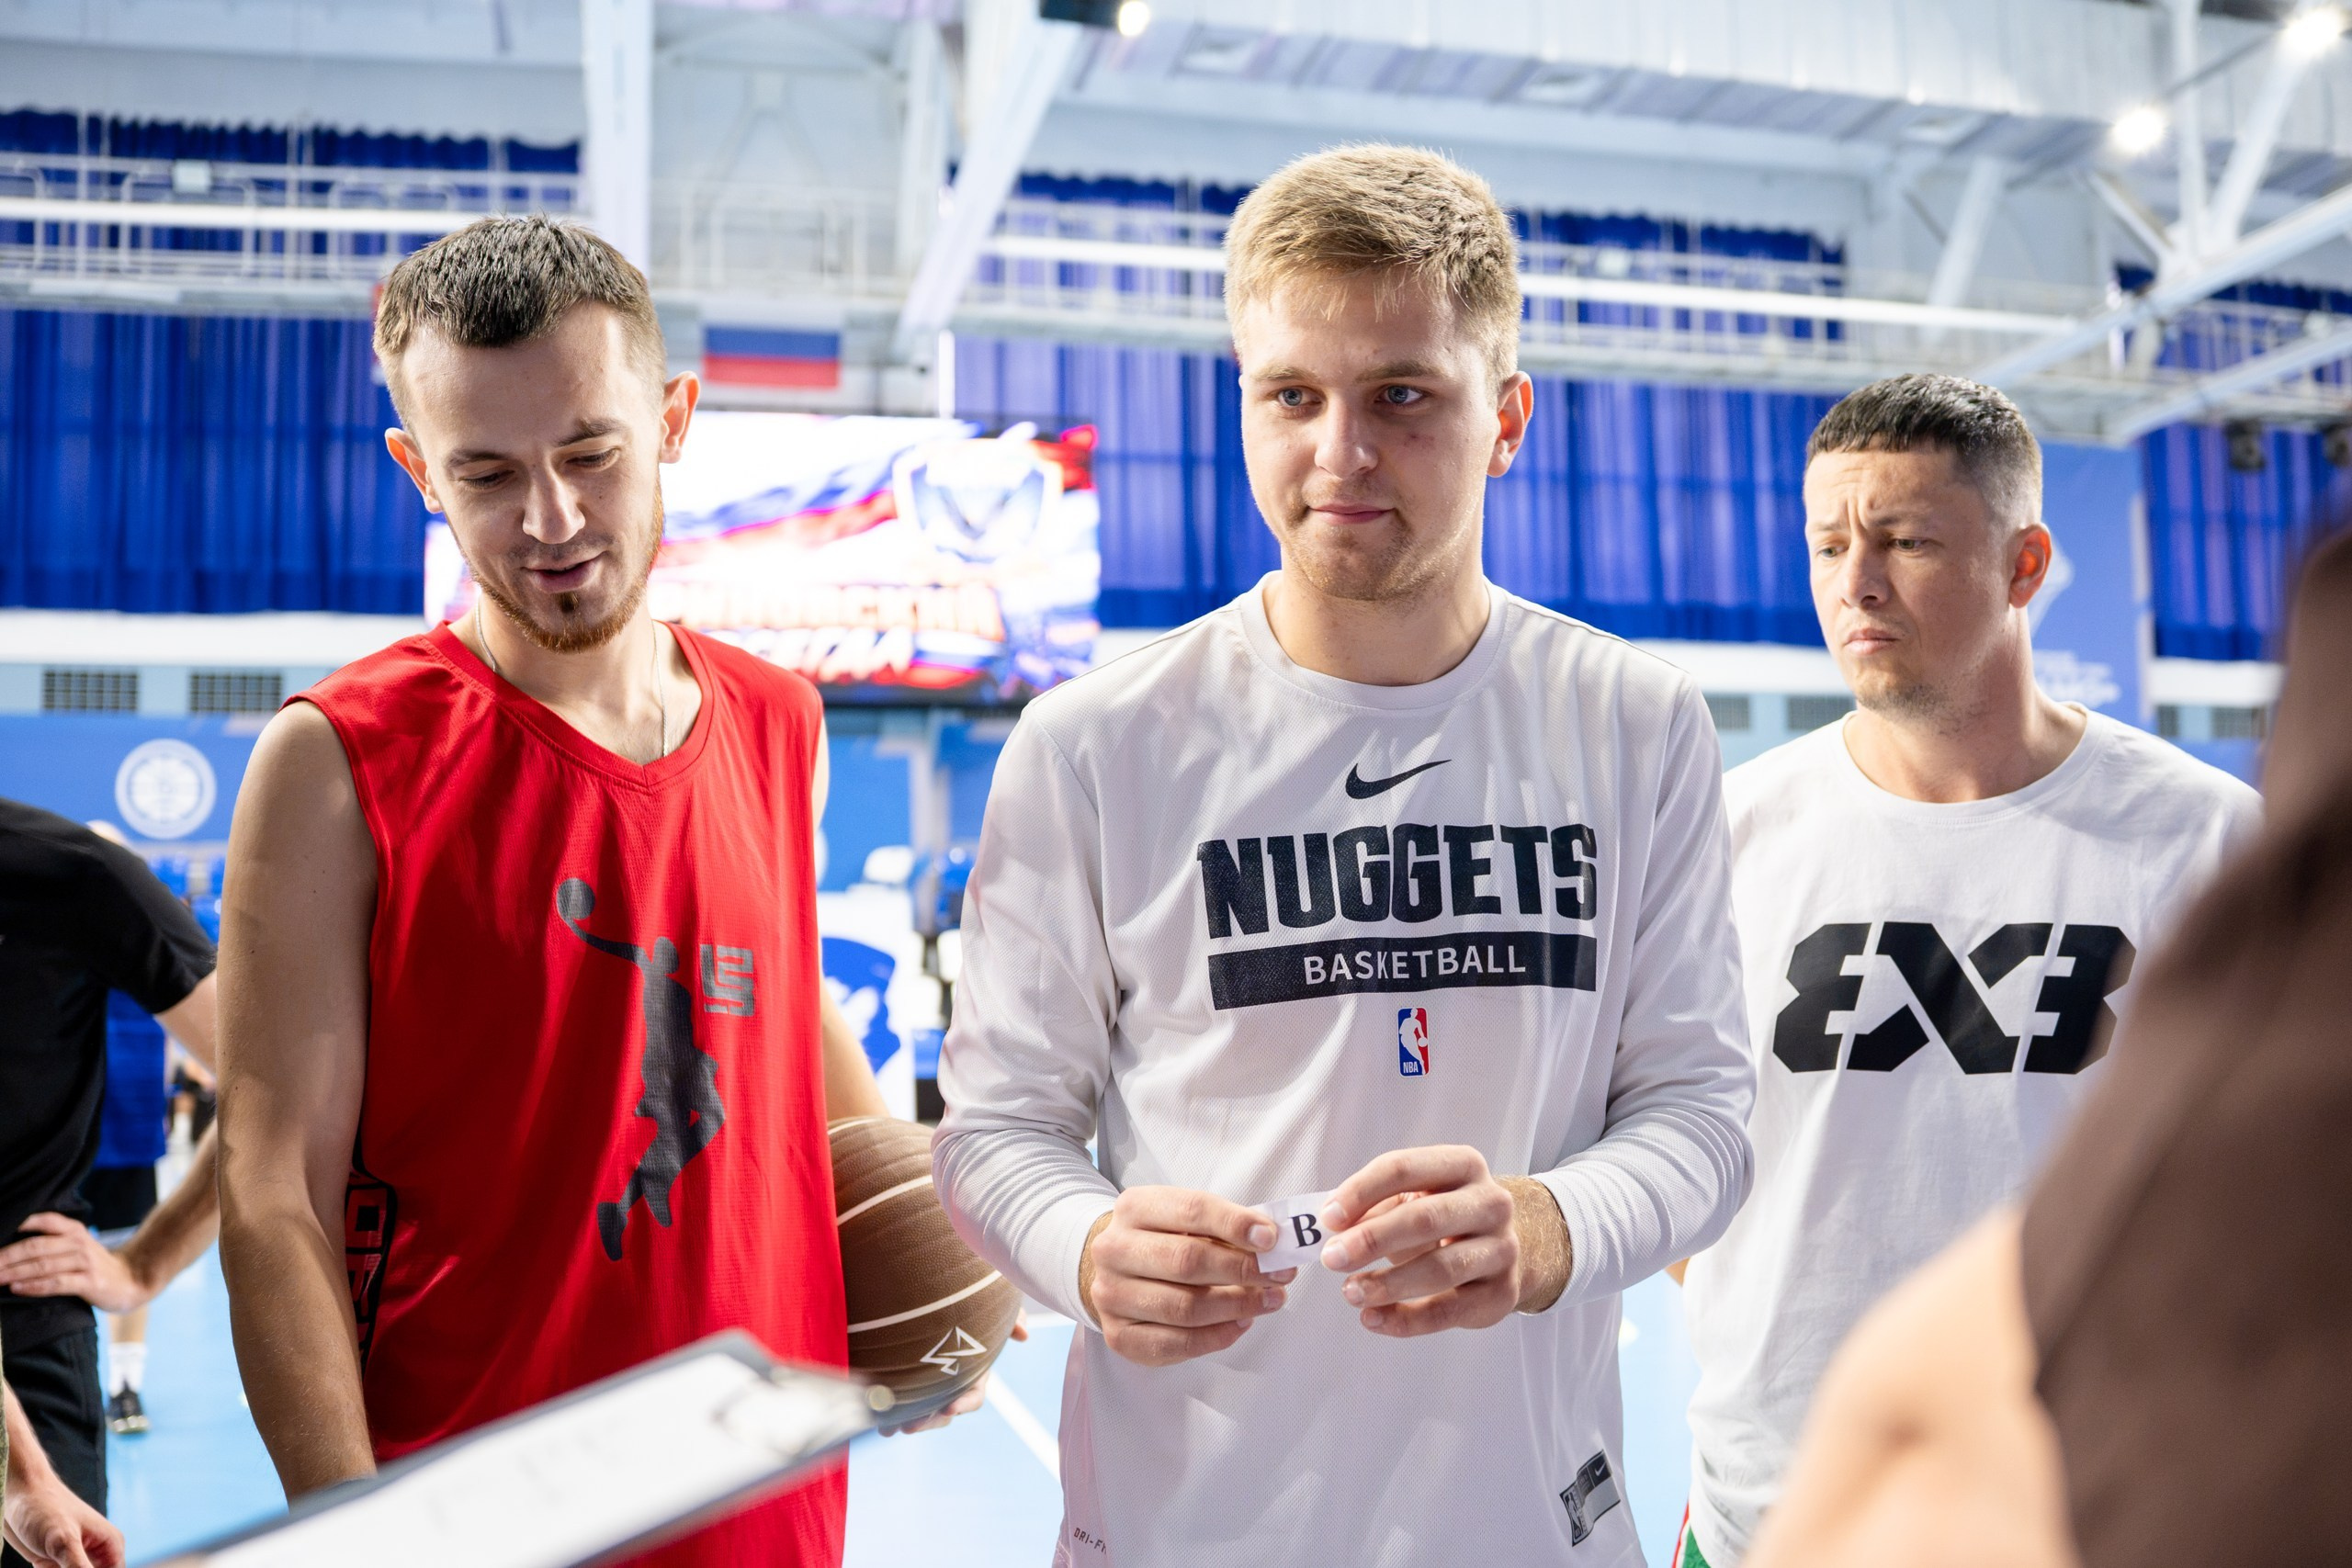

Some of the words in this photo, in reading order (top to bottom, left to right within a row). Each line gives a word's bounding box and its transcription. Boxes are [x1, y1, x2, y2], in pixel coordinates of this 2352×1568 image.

[1197, 824, 1597, 939] NUGGETS
[1304, 944, 1526, 986] BASKETBALL
[1403, 1061, 1419, 1074] NBA
[1288, 1213, 1322, 1248] B
